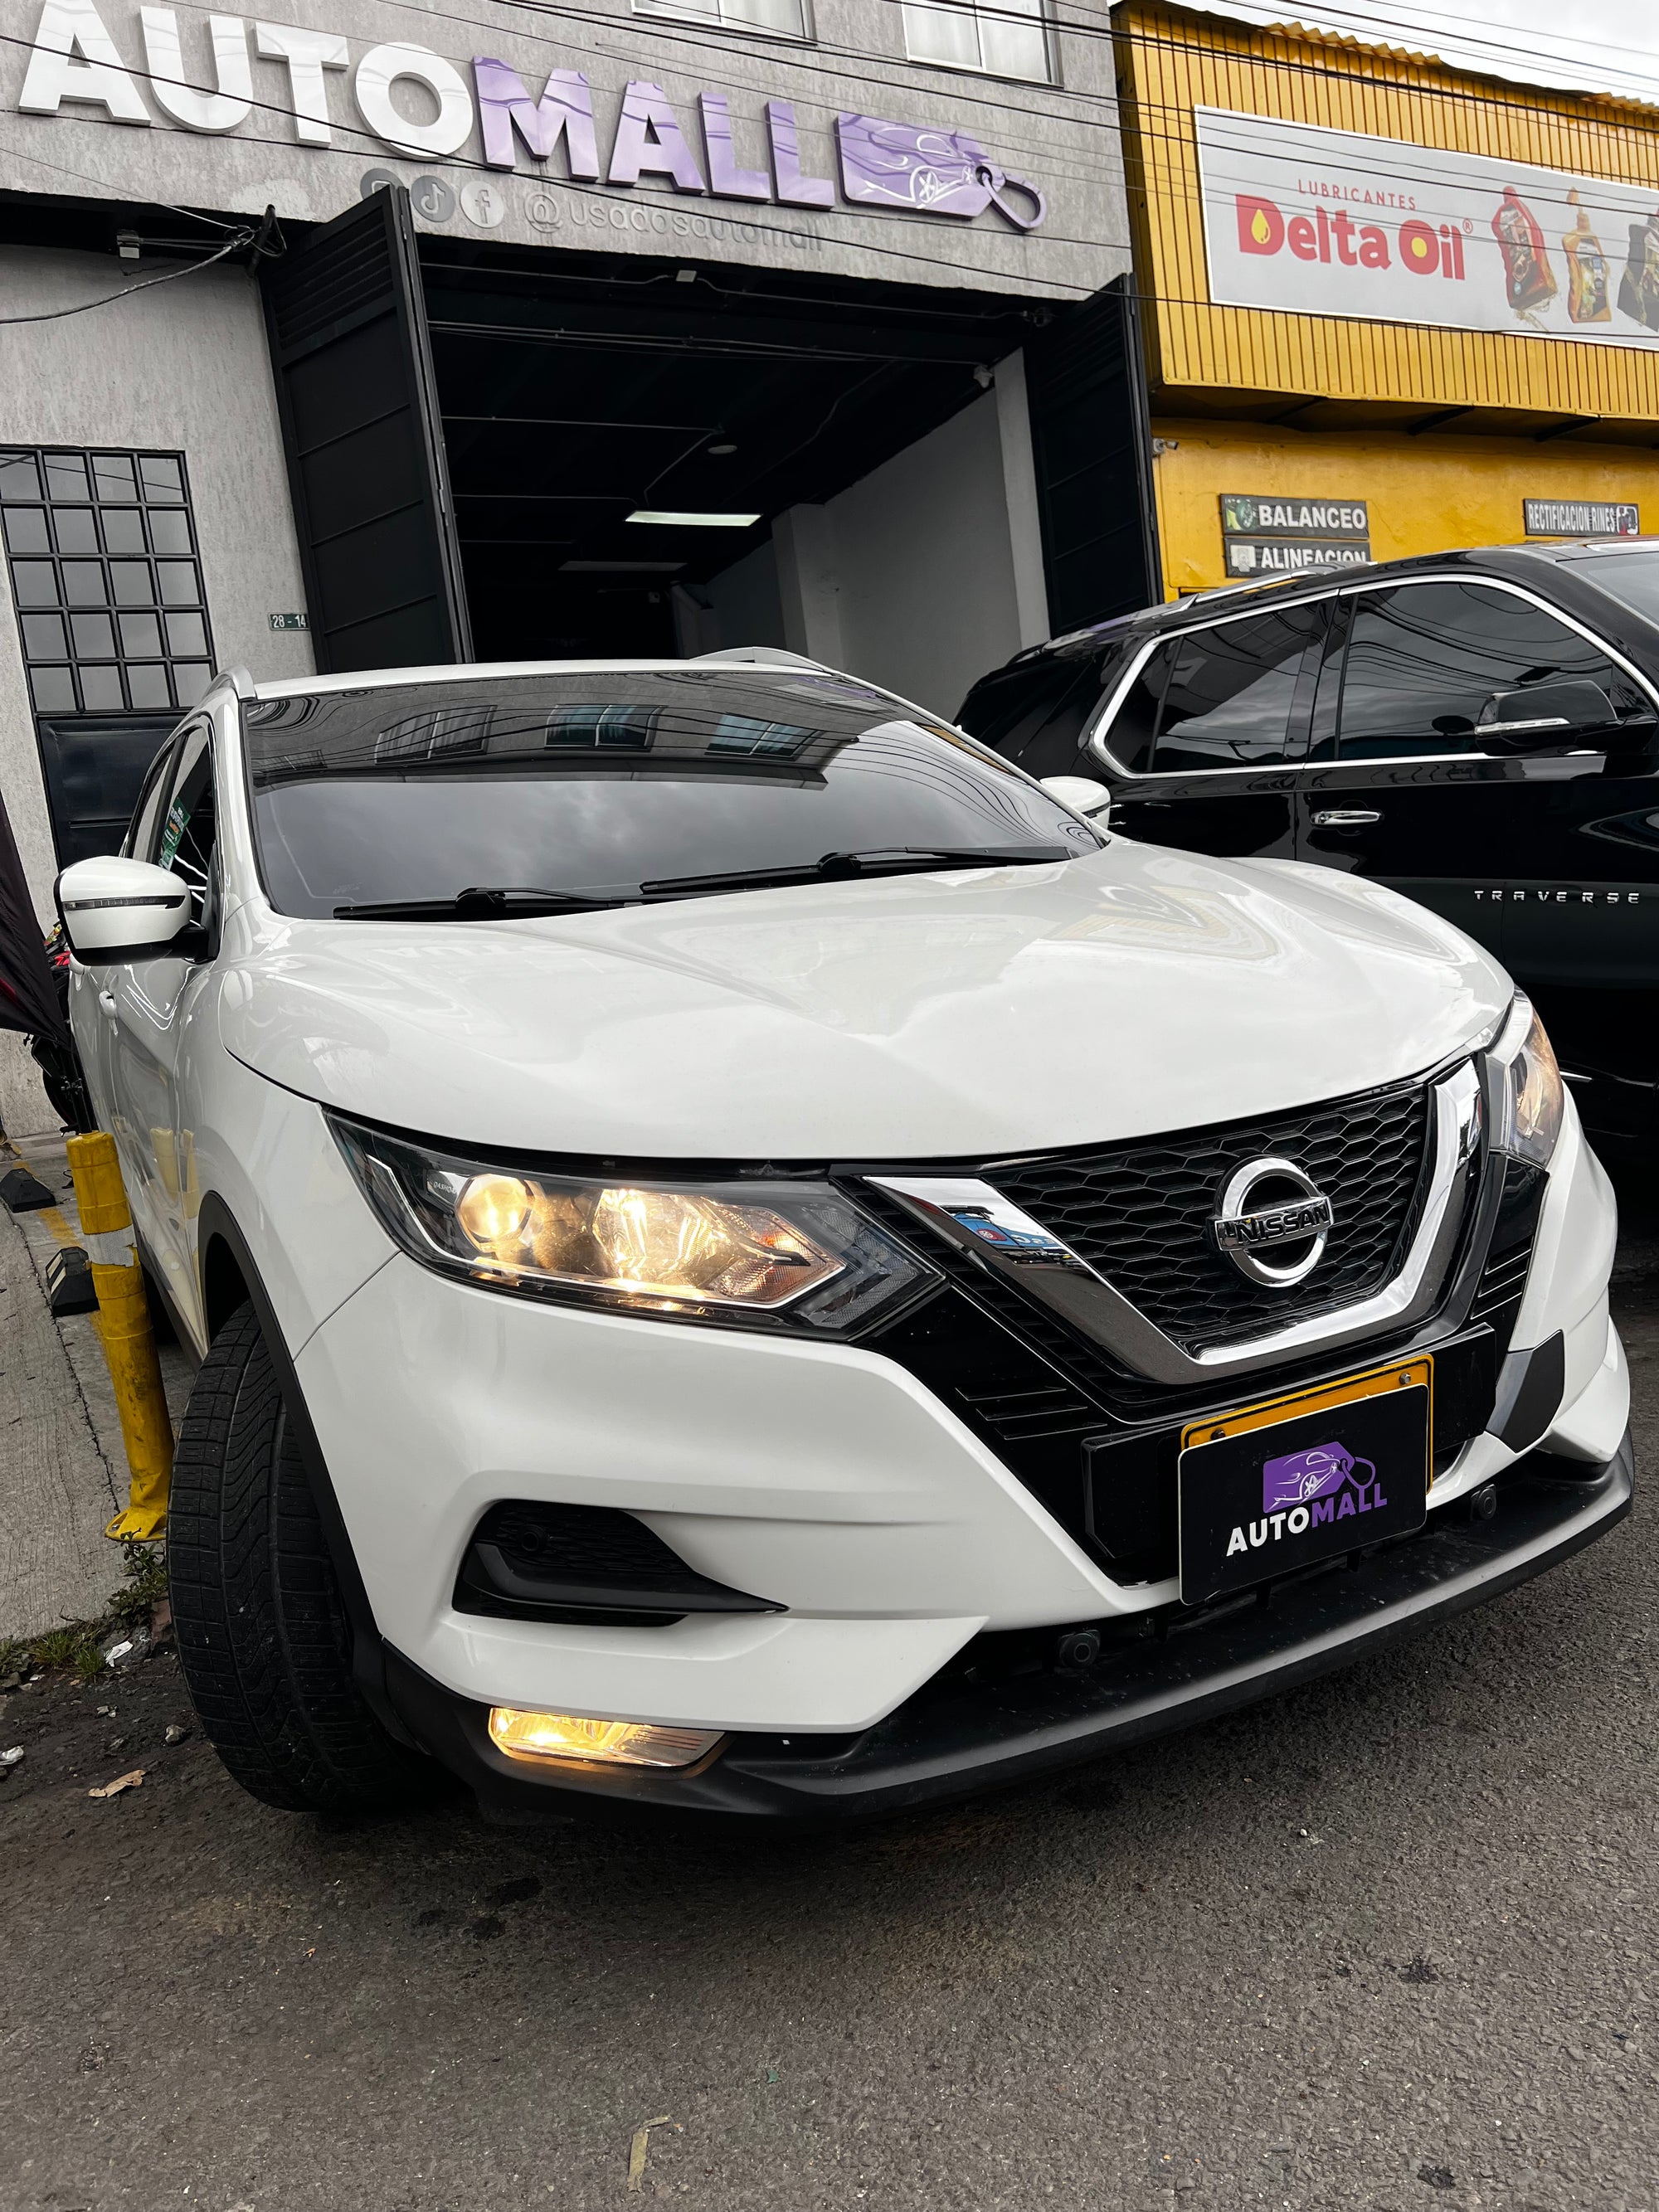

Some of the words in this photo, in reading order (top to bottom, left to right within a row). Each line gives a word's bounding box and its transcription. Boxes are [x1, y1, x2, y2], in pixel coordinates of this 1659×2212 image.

[18, 0, 835, 211] AUTOMALL
[1297, 178, 1417, 211] LUBRICANTES
[524, 192, 823, 252] @usadosautomall
[1235, 193, 1392, 270] Delta
[1258, 504, 1366, 529] BALANCEO
[1528, 503, 1590, 531] RECTIFICACION
[1592, 507, 1615, 532] RINES
[1474, 890, 1640, 904] TRAVERSE
[1236, 1203, 1331, 1244] NISSAN
[1226, 1483, 1388, 1556] AUTOMALL
